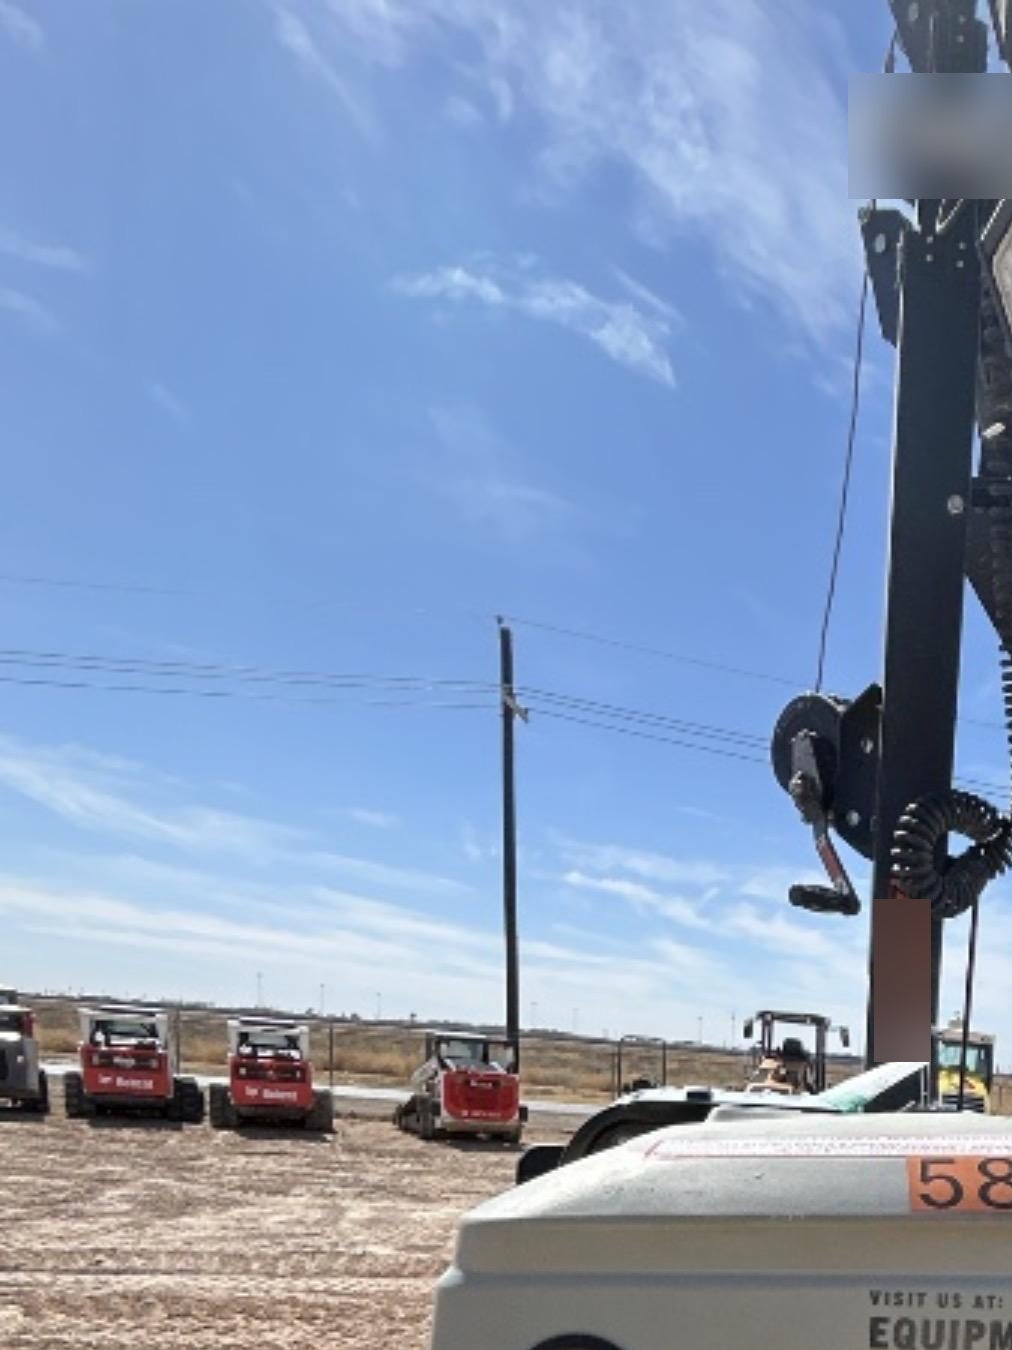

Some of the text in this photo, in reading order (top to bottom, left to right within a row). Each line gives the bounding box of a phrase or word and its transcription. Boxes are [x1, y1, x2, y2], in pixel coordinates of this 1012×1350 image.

[869, 1290, 1004, 1309] VISIT US AT:
